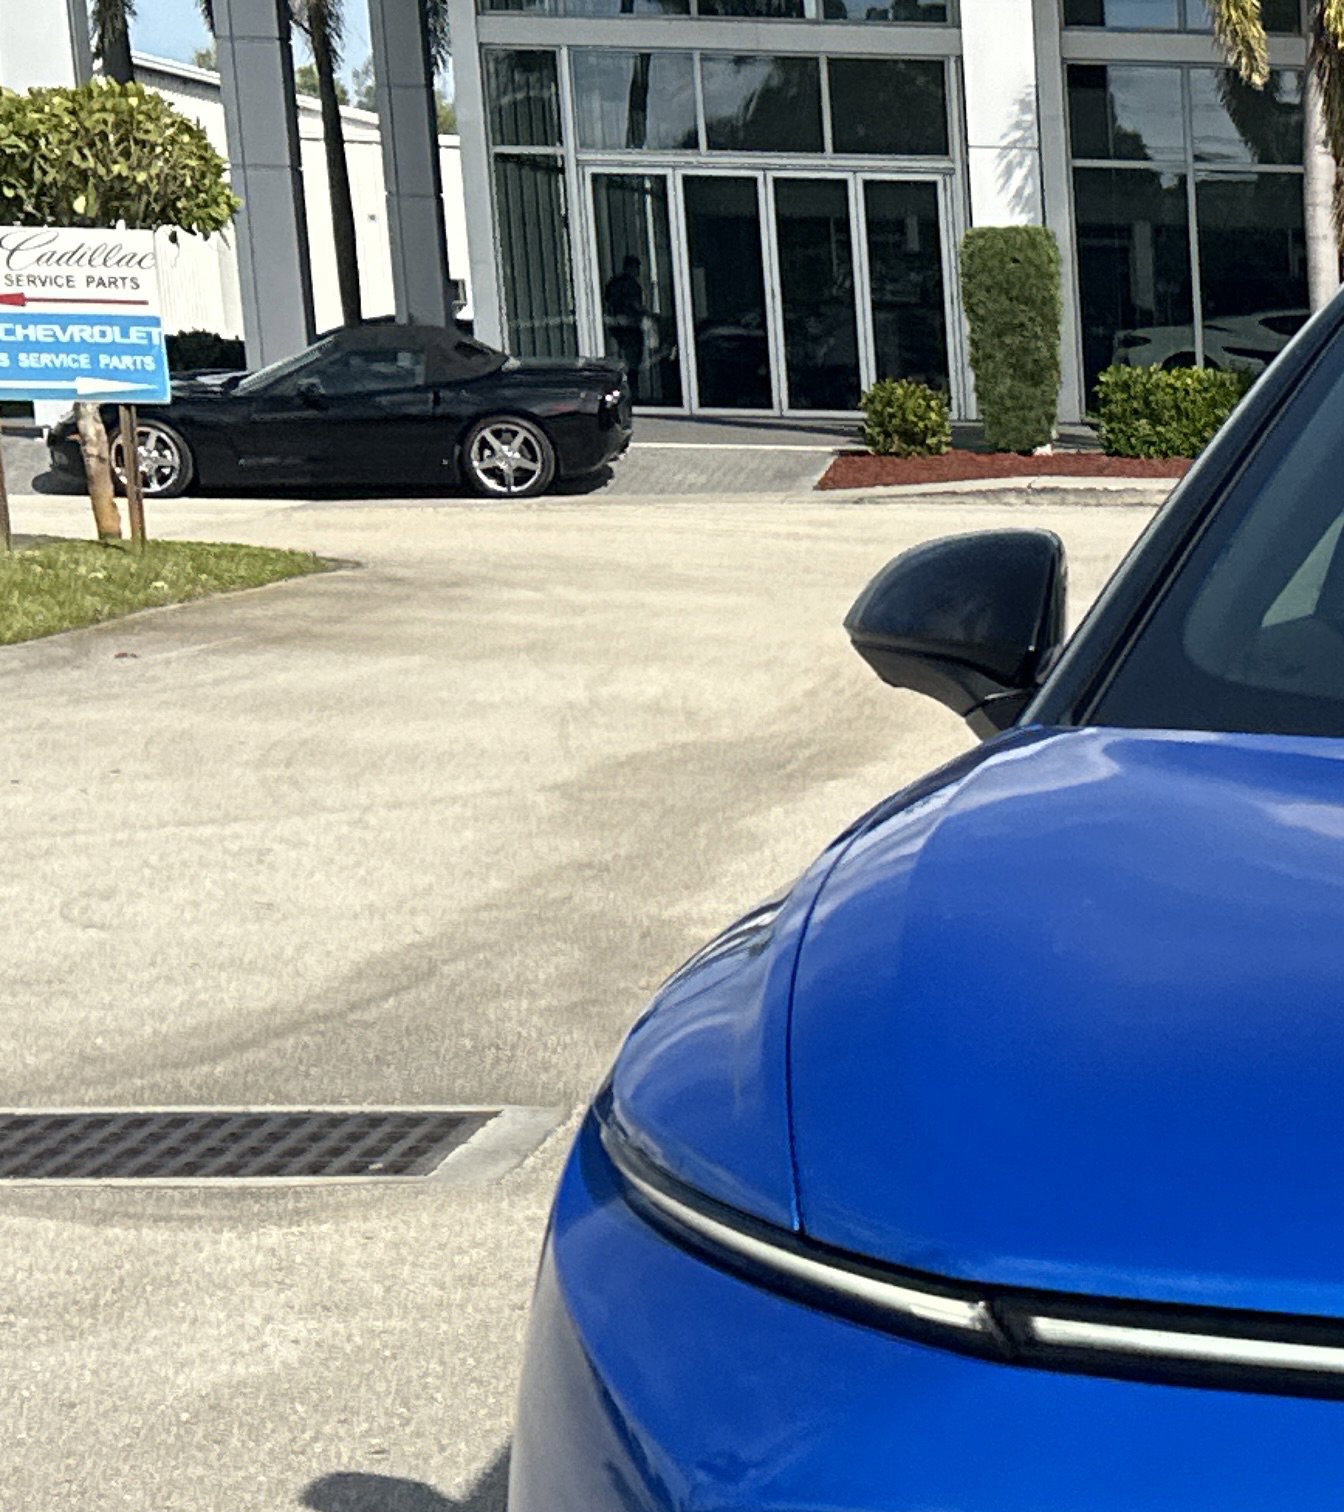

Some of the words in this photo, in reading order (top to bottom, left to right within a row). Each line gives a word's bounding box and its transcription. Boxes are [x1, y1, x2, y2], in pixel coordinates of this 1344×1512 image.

[0, 230, 156, 271] Cadillac
[4, 273, 76, 289] SERVICE
[86, 275, 140, 290] PARTS
[0, 322, 162, 345] CHEVROLET
[18, 352, 91, 369] SERVICE
[99, 354, 156, 371] PARTS
